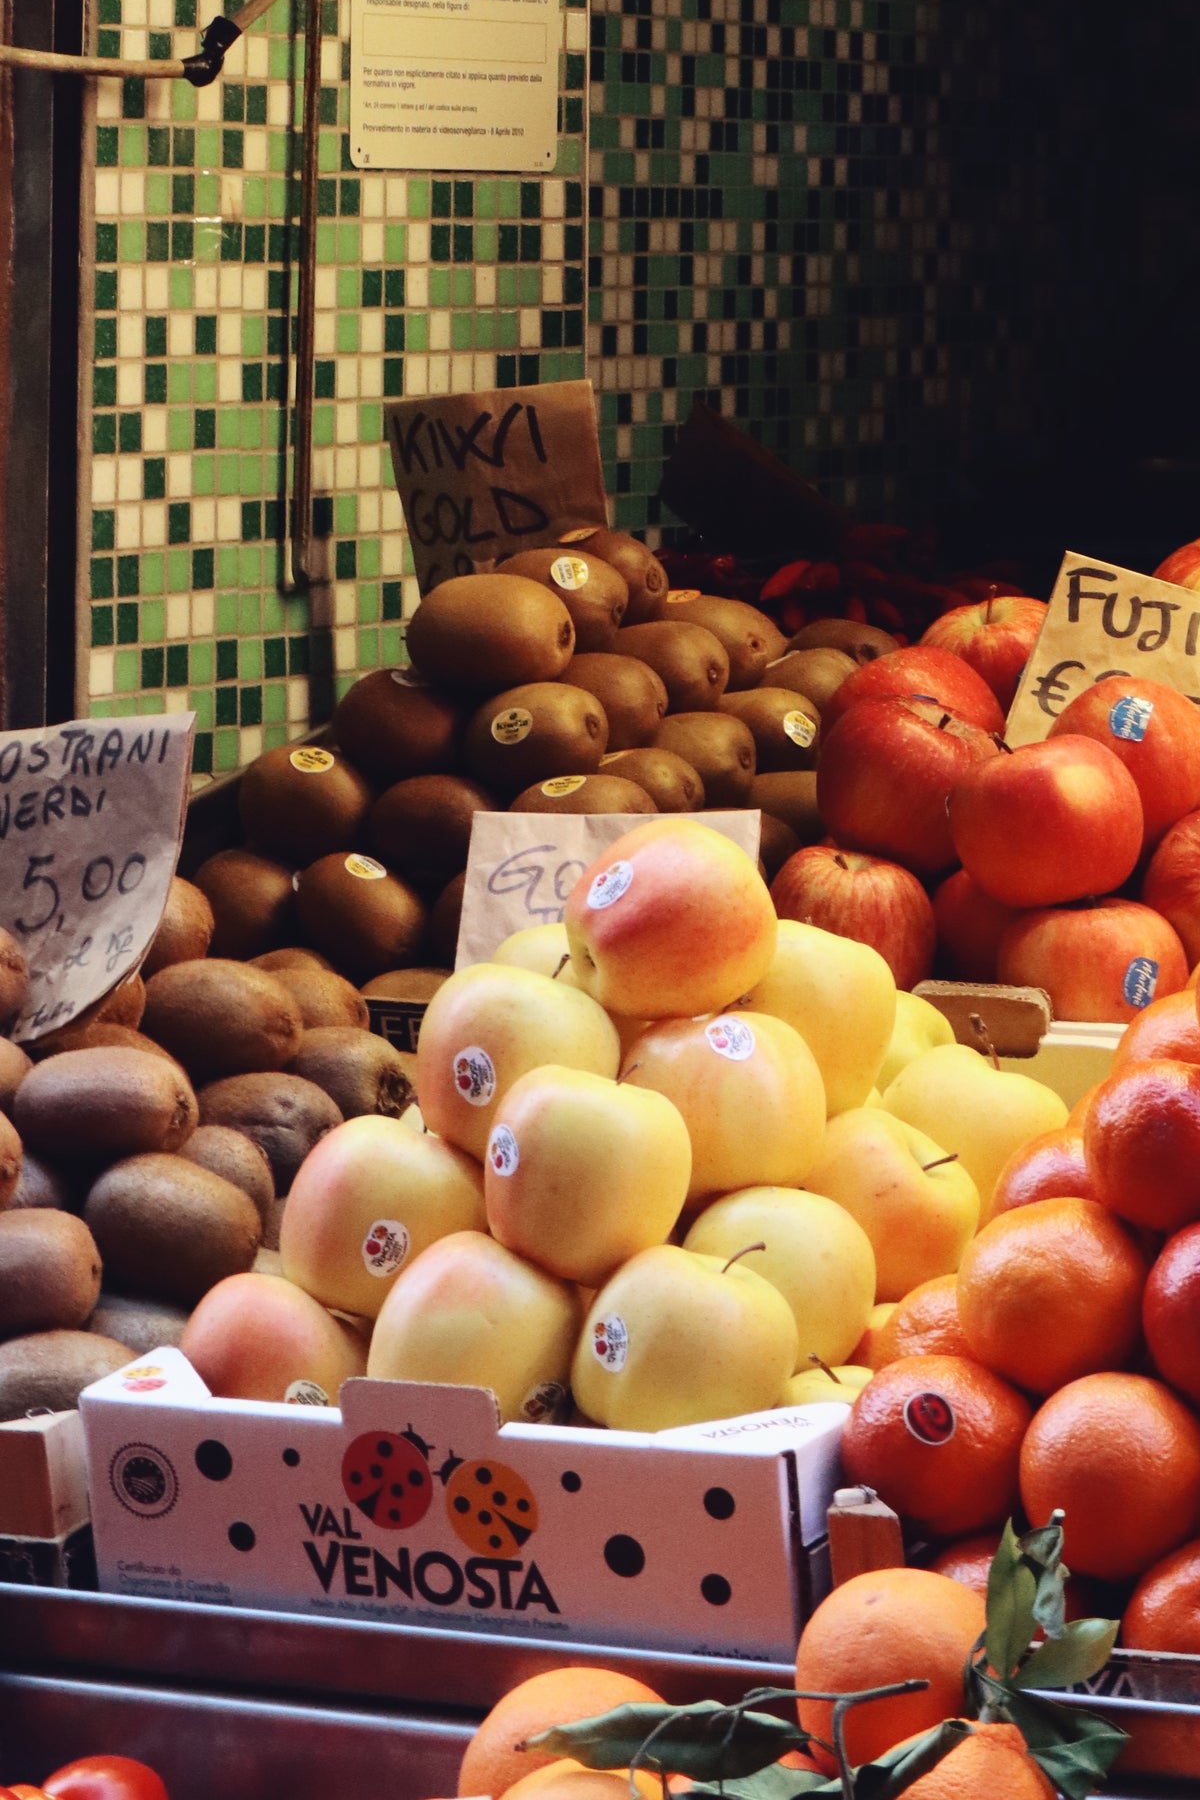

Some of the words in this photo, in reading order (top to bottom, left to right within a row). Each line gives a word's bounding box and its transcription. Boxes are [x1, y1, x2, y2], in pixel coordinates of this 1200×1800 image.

[393, 402, 547, 474] KIWI
[410, 486, 550, 546] GOLD
[14, 851, 146, 933] 5,00
[298, 1502, 362, 1540] VAL
[302, 1540, 561, 1615] VENOSTA
